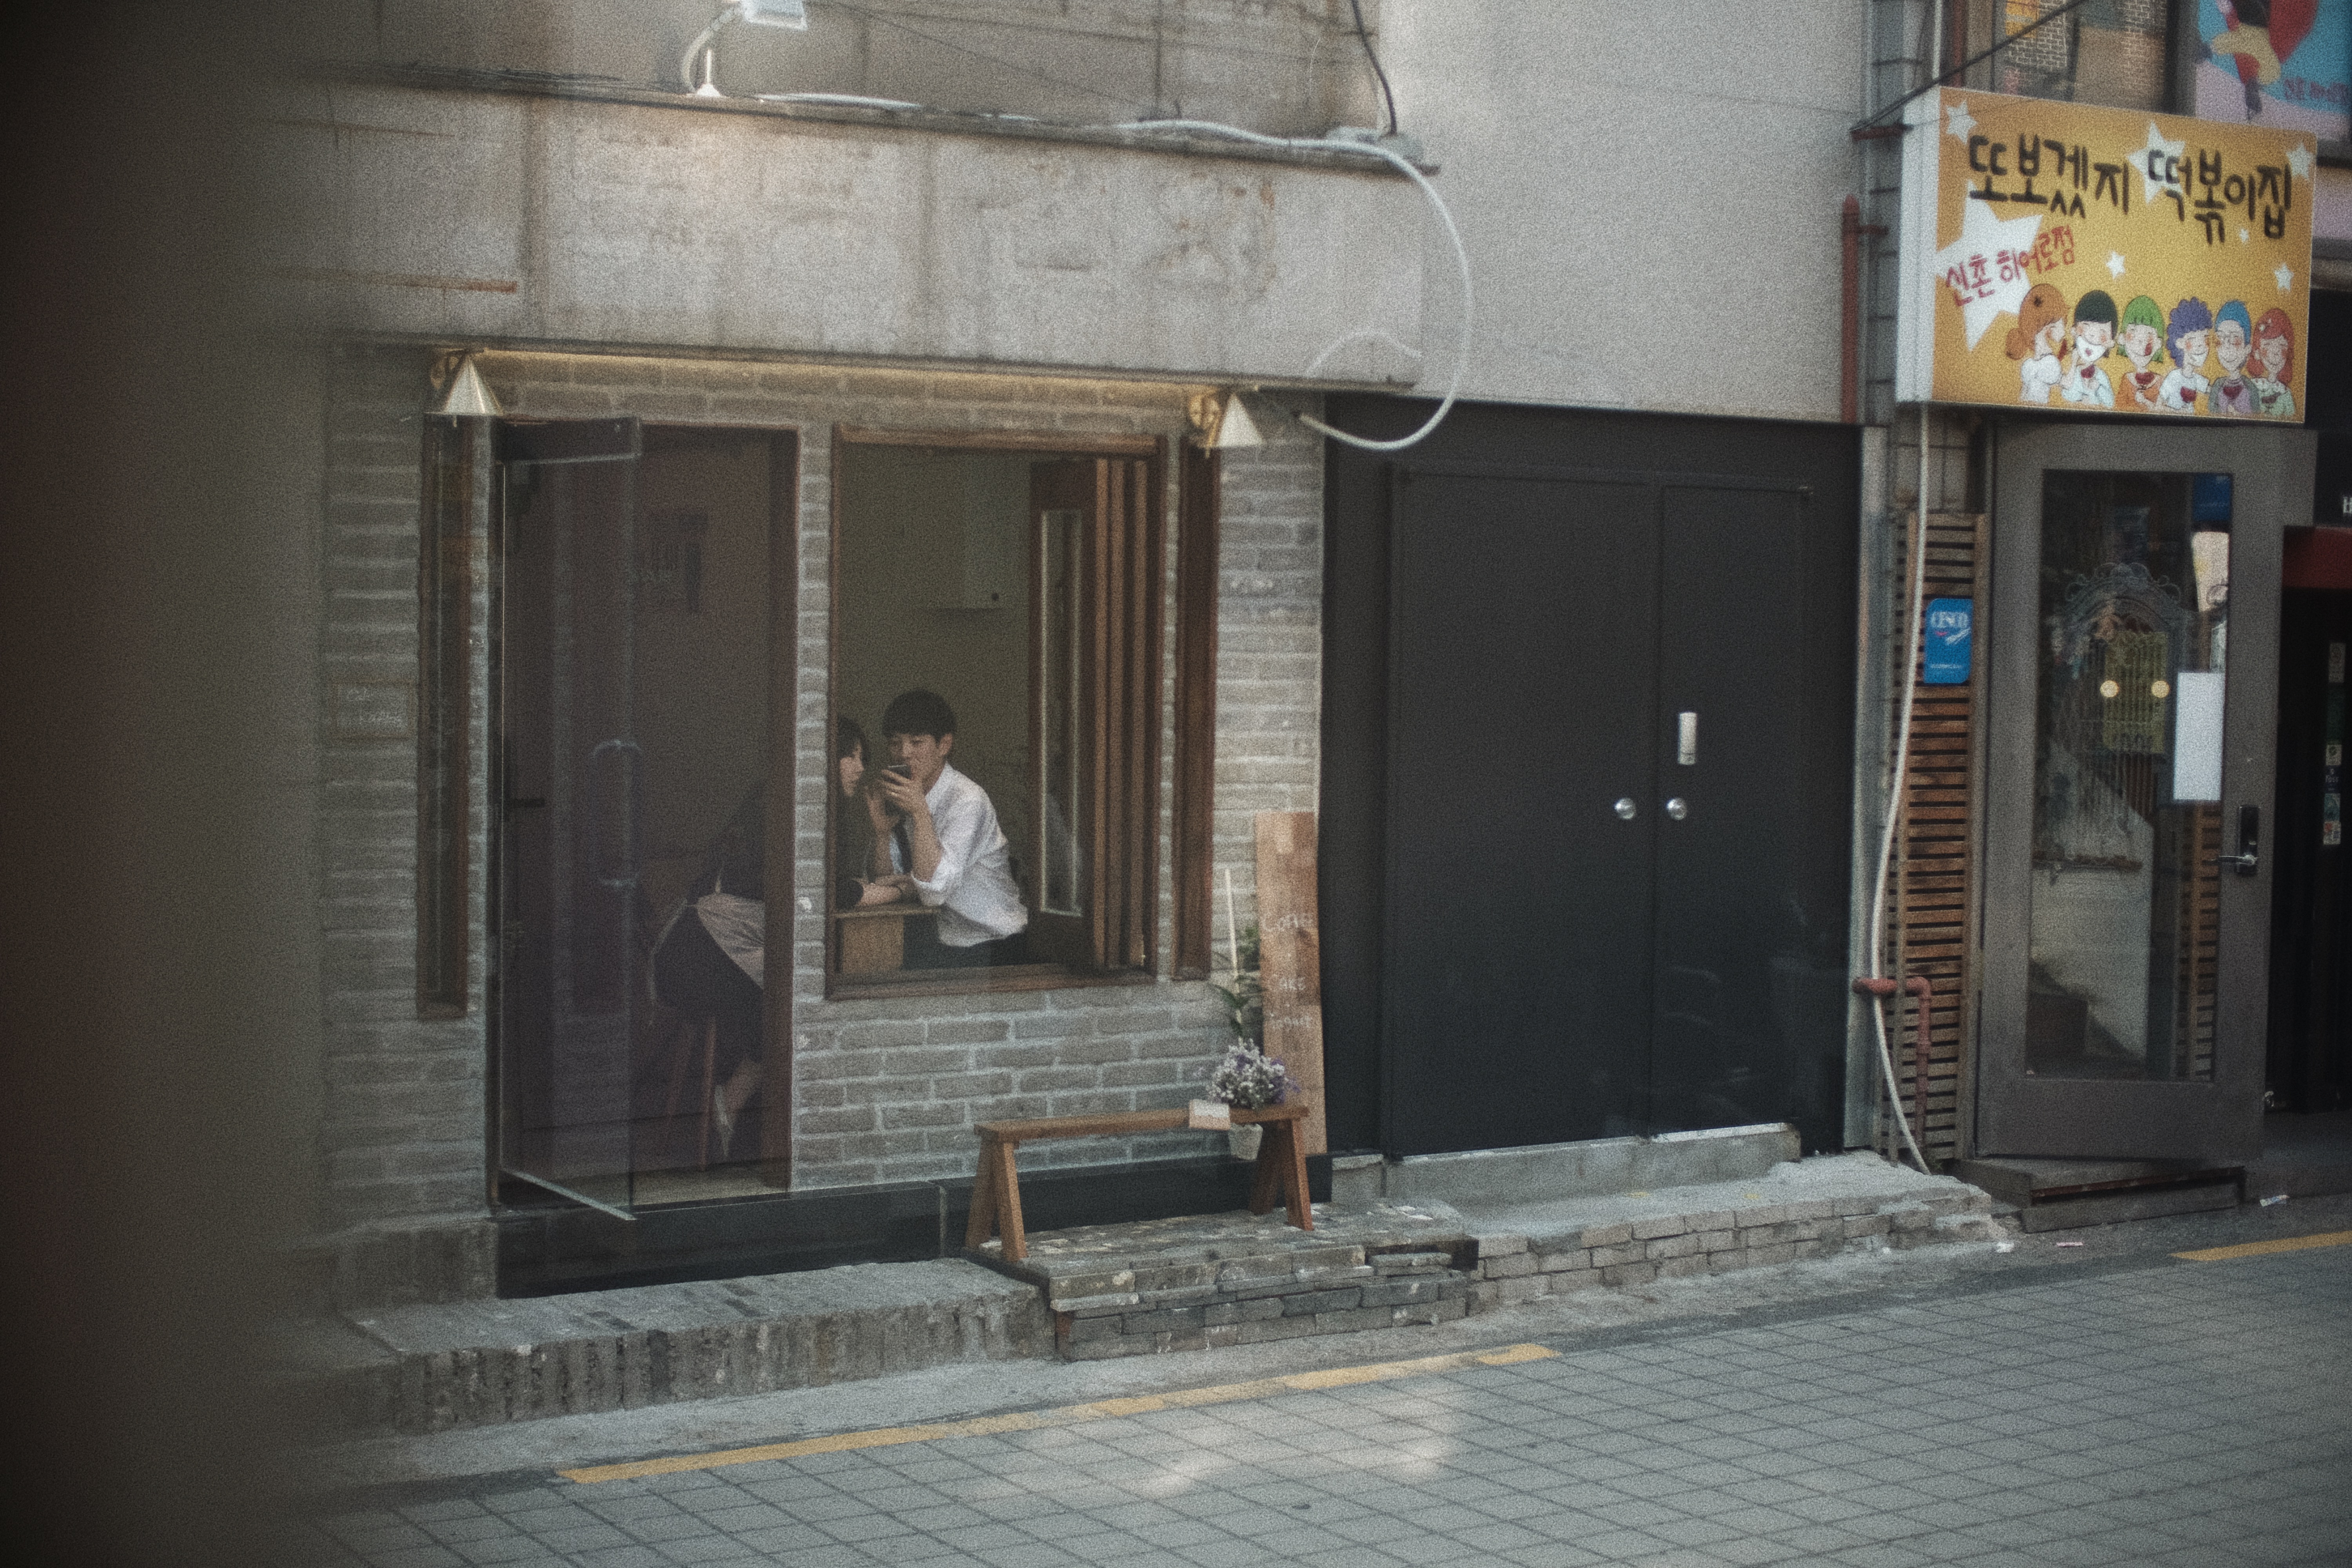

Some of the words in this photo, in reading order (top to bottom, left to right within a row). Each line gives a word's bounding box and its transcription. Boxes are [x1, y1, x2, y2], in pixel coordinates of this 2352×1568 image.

[1969, 133, 2129, 219] 또보겠지
[2147, 148, 2292, 244] 떡볶이집
[1945, 254, 1995, 307] 신촌
[1996, 223, 2075, 282] 히어로점
